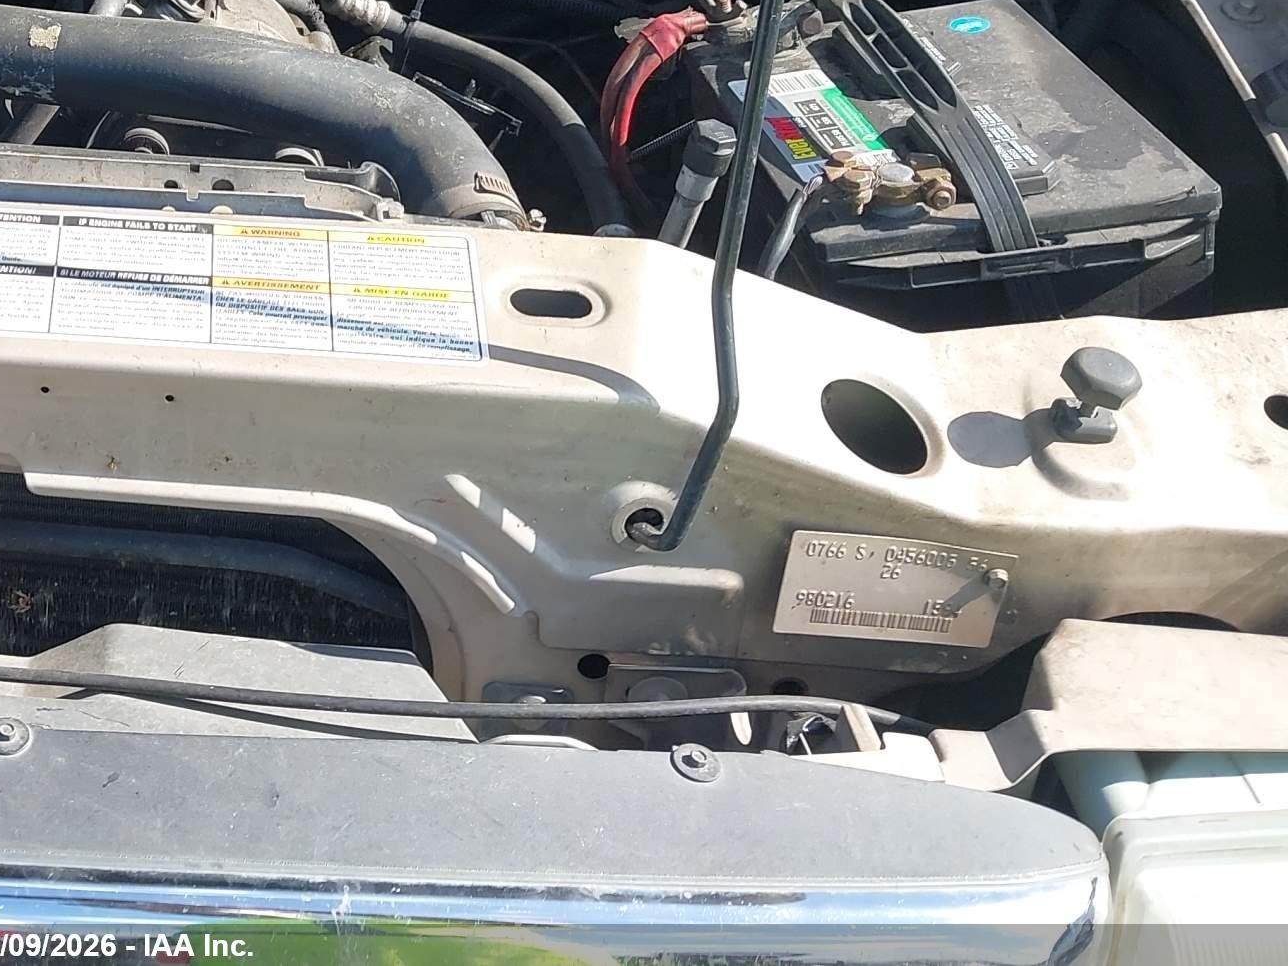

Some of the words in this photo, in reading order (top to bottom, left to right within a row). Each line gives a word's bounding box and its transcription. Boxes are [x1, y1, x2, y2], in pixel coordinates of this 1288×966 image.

[78, 218, 87, 226] IF
[89, 218, 124, 228] ENGINE
[124, 220, 151, 230] FAILS
[151, 221, 166, 231] TO
[167, 223, 197, 232] START
[251, 229, 301, 237] WARNING
[81, 270, 116, 279] MOTEUR
[116, 273, 149, 282] REFUSE
[149, 274, 162, 283] DE
[233, 280, 321, 291] AVERTISSEMENT
[806, 539, 847, 559] 0766
[879, 562, 902, 580] 26
